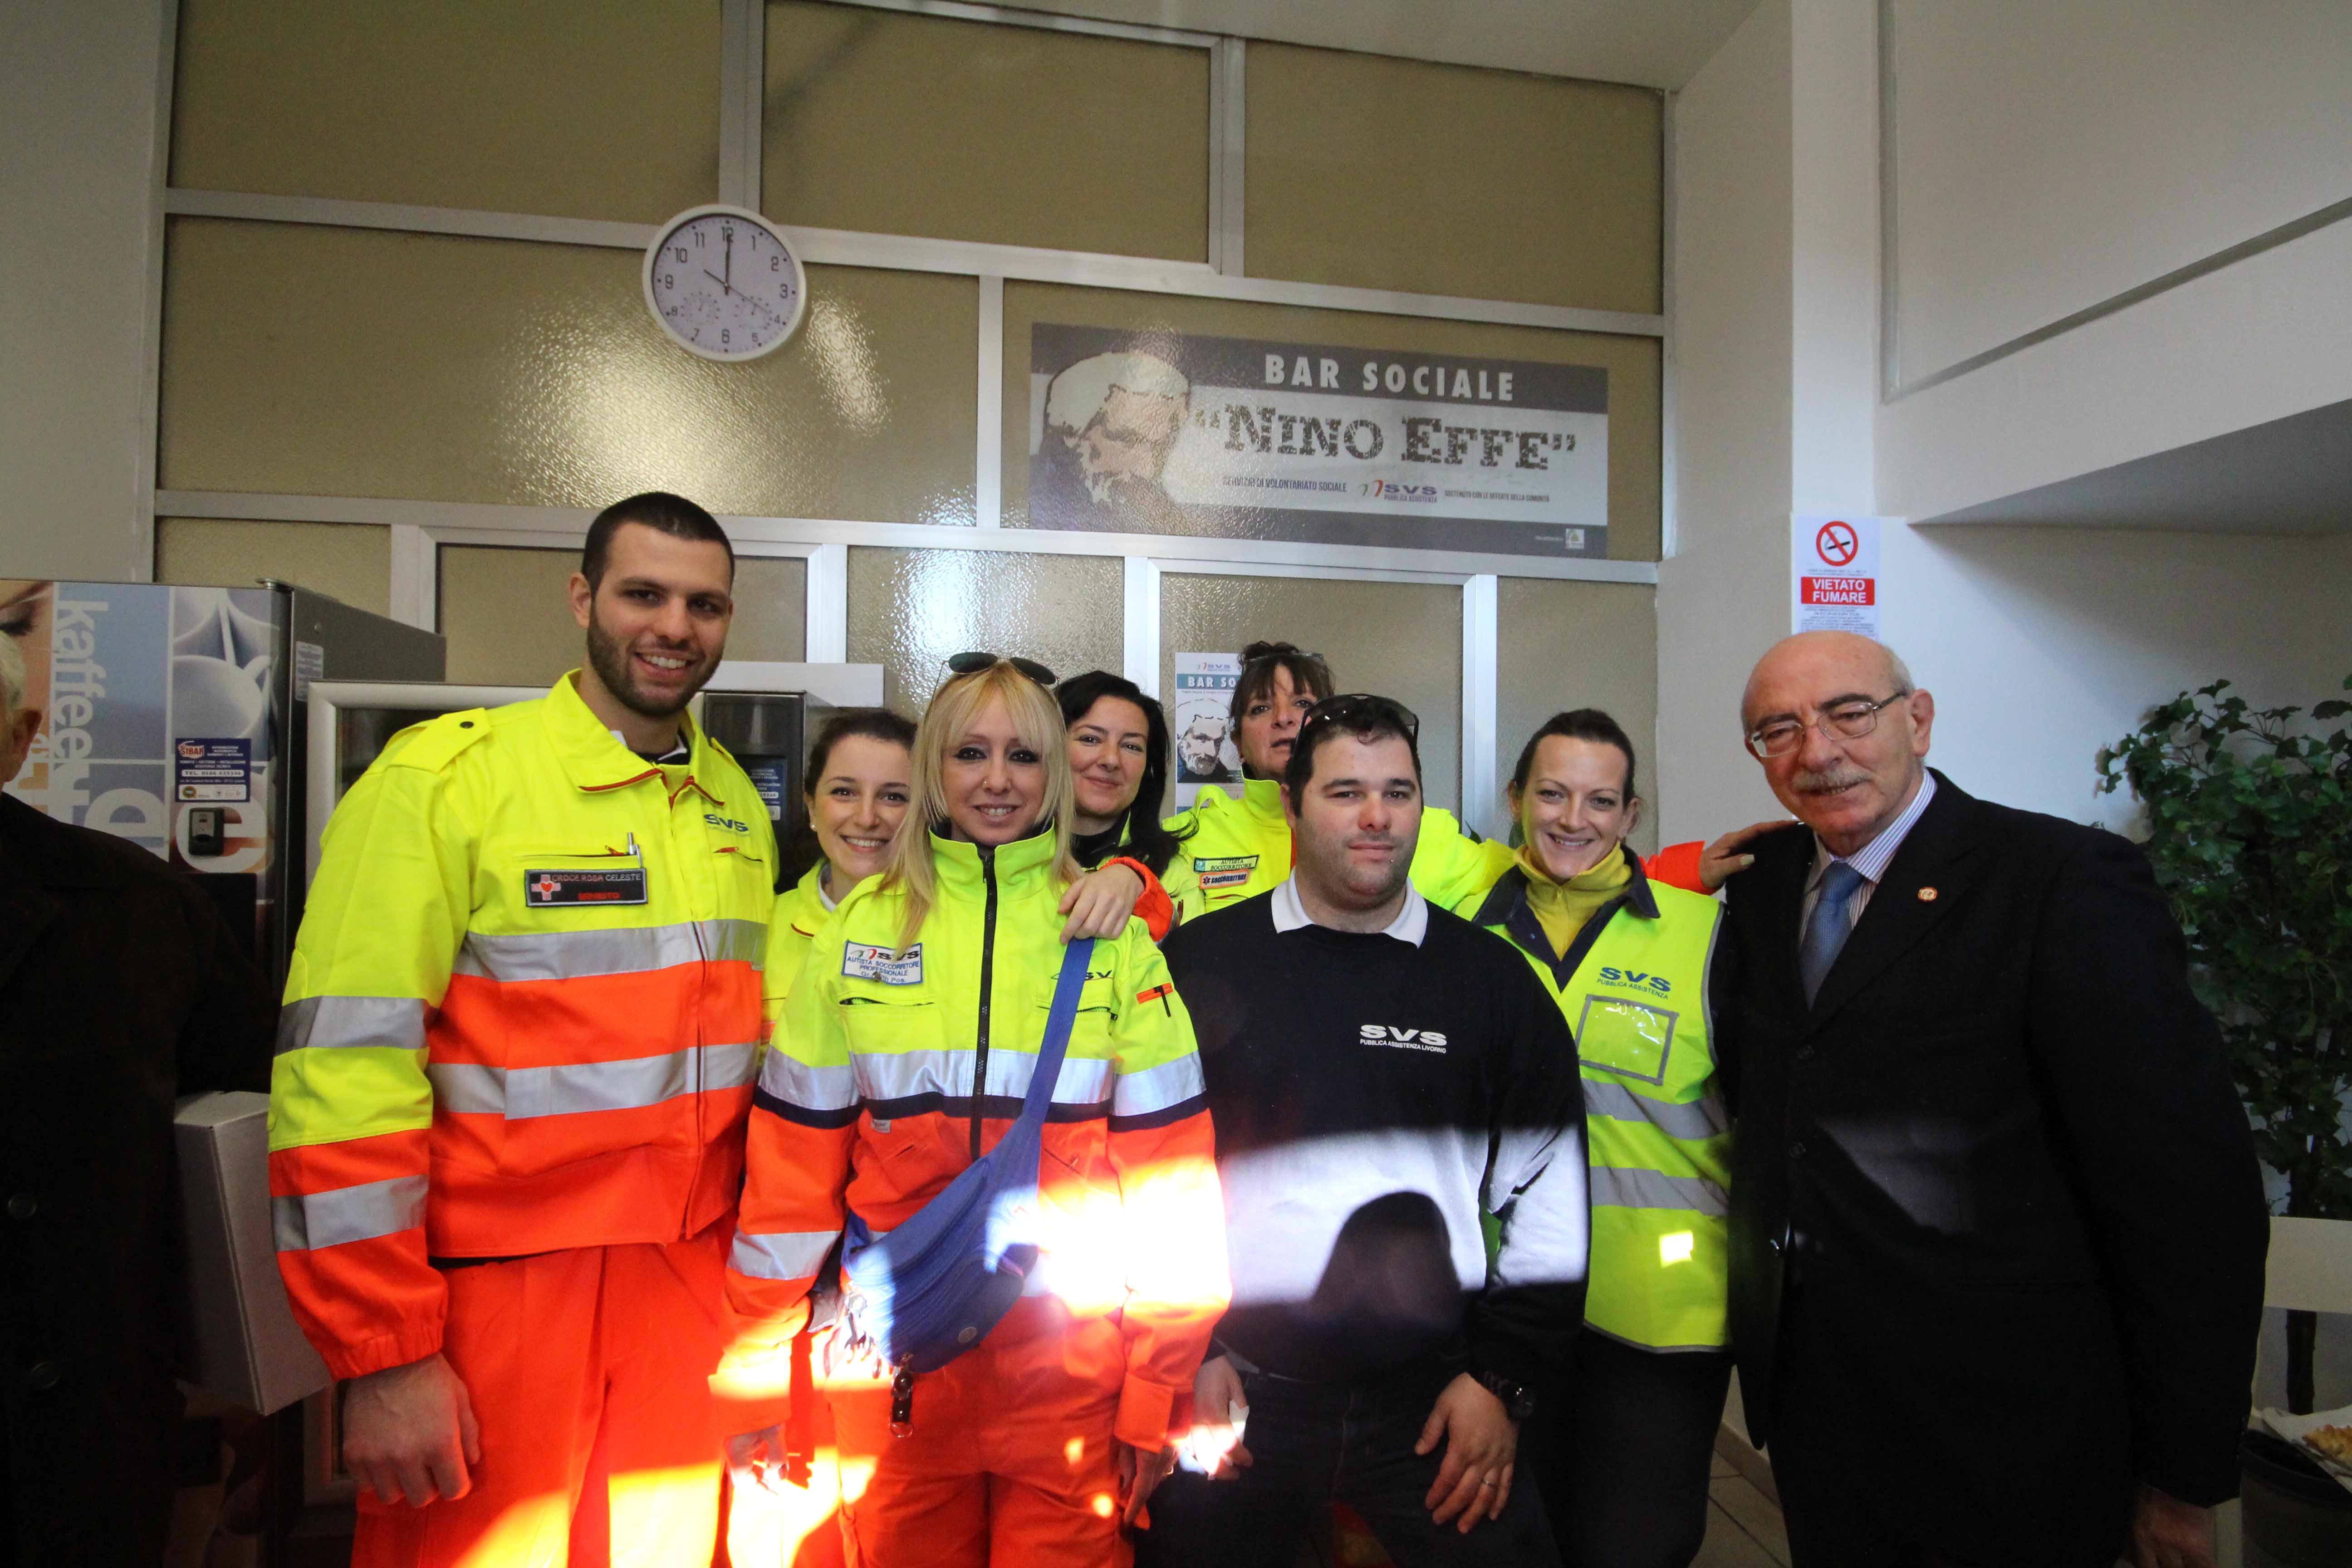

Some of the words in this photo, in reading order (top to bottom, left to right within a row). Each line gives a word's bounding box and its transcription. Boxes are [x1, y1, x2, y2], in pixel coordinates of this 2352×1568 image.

[695, 232, 705, 248] 11
[751, 235, 756, 250] 1
[675, 248, 687, 263] 10
[771, 256, 779, 272] 2
[665, 274, 673, 289] 9
[780, 284, 788, 298] 3
[671, 306, 678, 316] 8
[774, 314, 780, 323] 4
[693, 328, 700, 338] 7
[722, 329, 730, 343] 6
[752, 333, 759, 342] 5
[1265, 354, 1340, 388] BAR
[1362, 362, 1514, 401] SOCIALE
[1265, 479, 1317, 490] VOLONTARIATO
[1318, 482, 1347, 492] SOCIALE
[1384, 484, 1437, 495] SVS
[1813, 579, 1865, 590] VIETATO
[1813, 591, 1866, 603] FUMARE
[53, 600, 109, 760] kaffee
[1188, 676, 1213, 687] BAR
[704, 814, 748, 832] SVS
[1211, 874, 1247, 883] SOCCORRITORE
[847, 956, 872, 965] AUTISTA
[876, 960, 920, 970] SOCCORRITORE
[860, 965, 907, 976] PROFESSIONALE
[1600, 967, 1671, 992] SVS
[1597, 978, 1627, 988] PUBBLICA
[1628, 983, 1668, 1000] ASSISTENZA
[1360, 1024, 1447, 1046] SVS
[1387, 1040, 1421, 1049] ASSISTENZA
